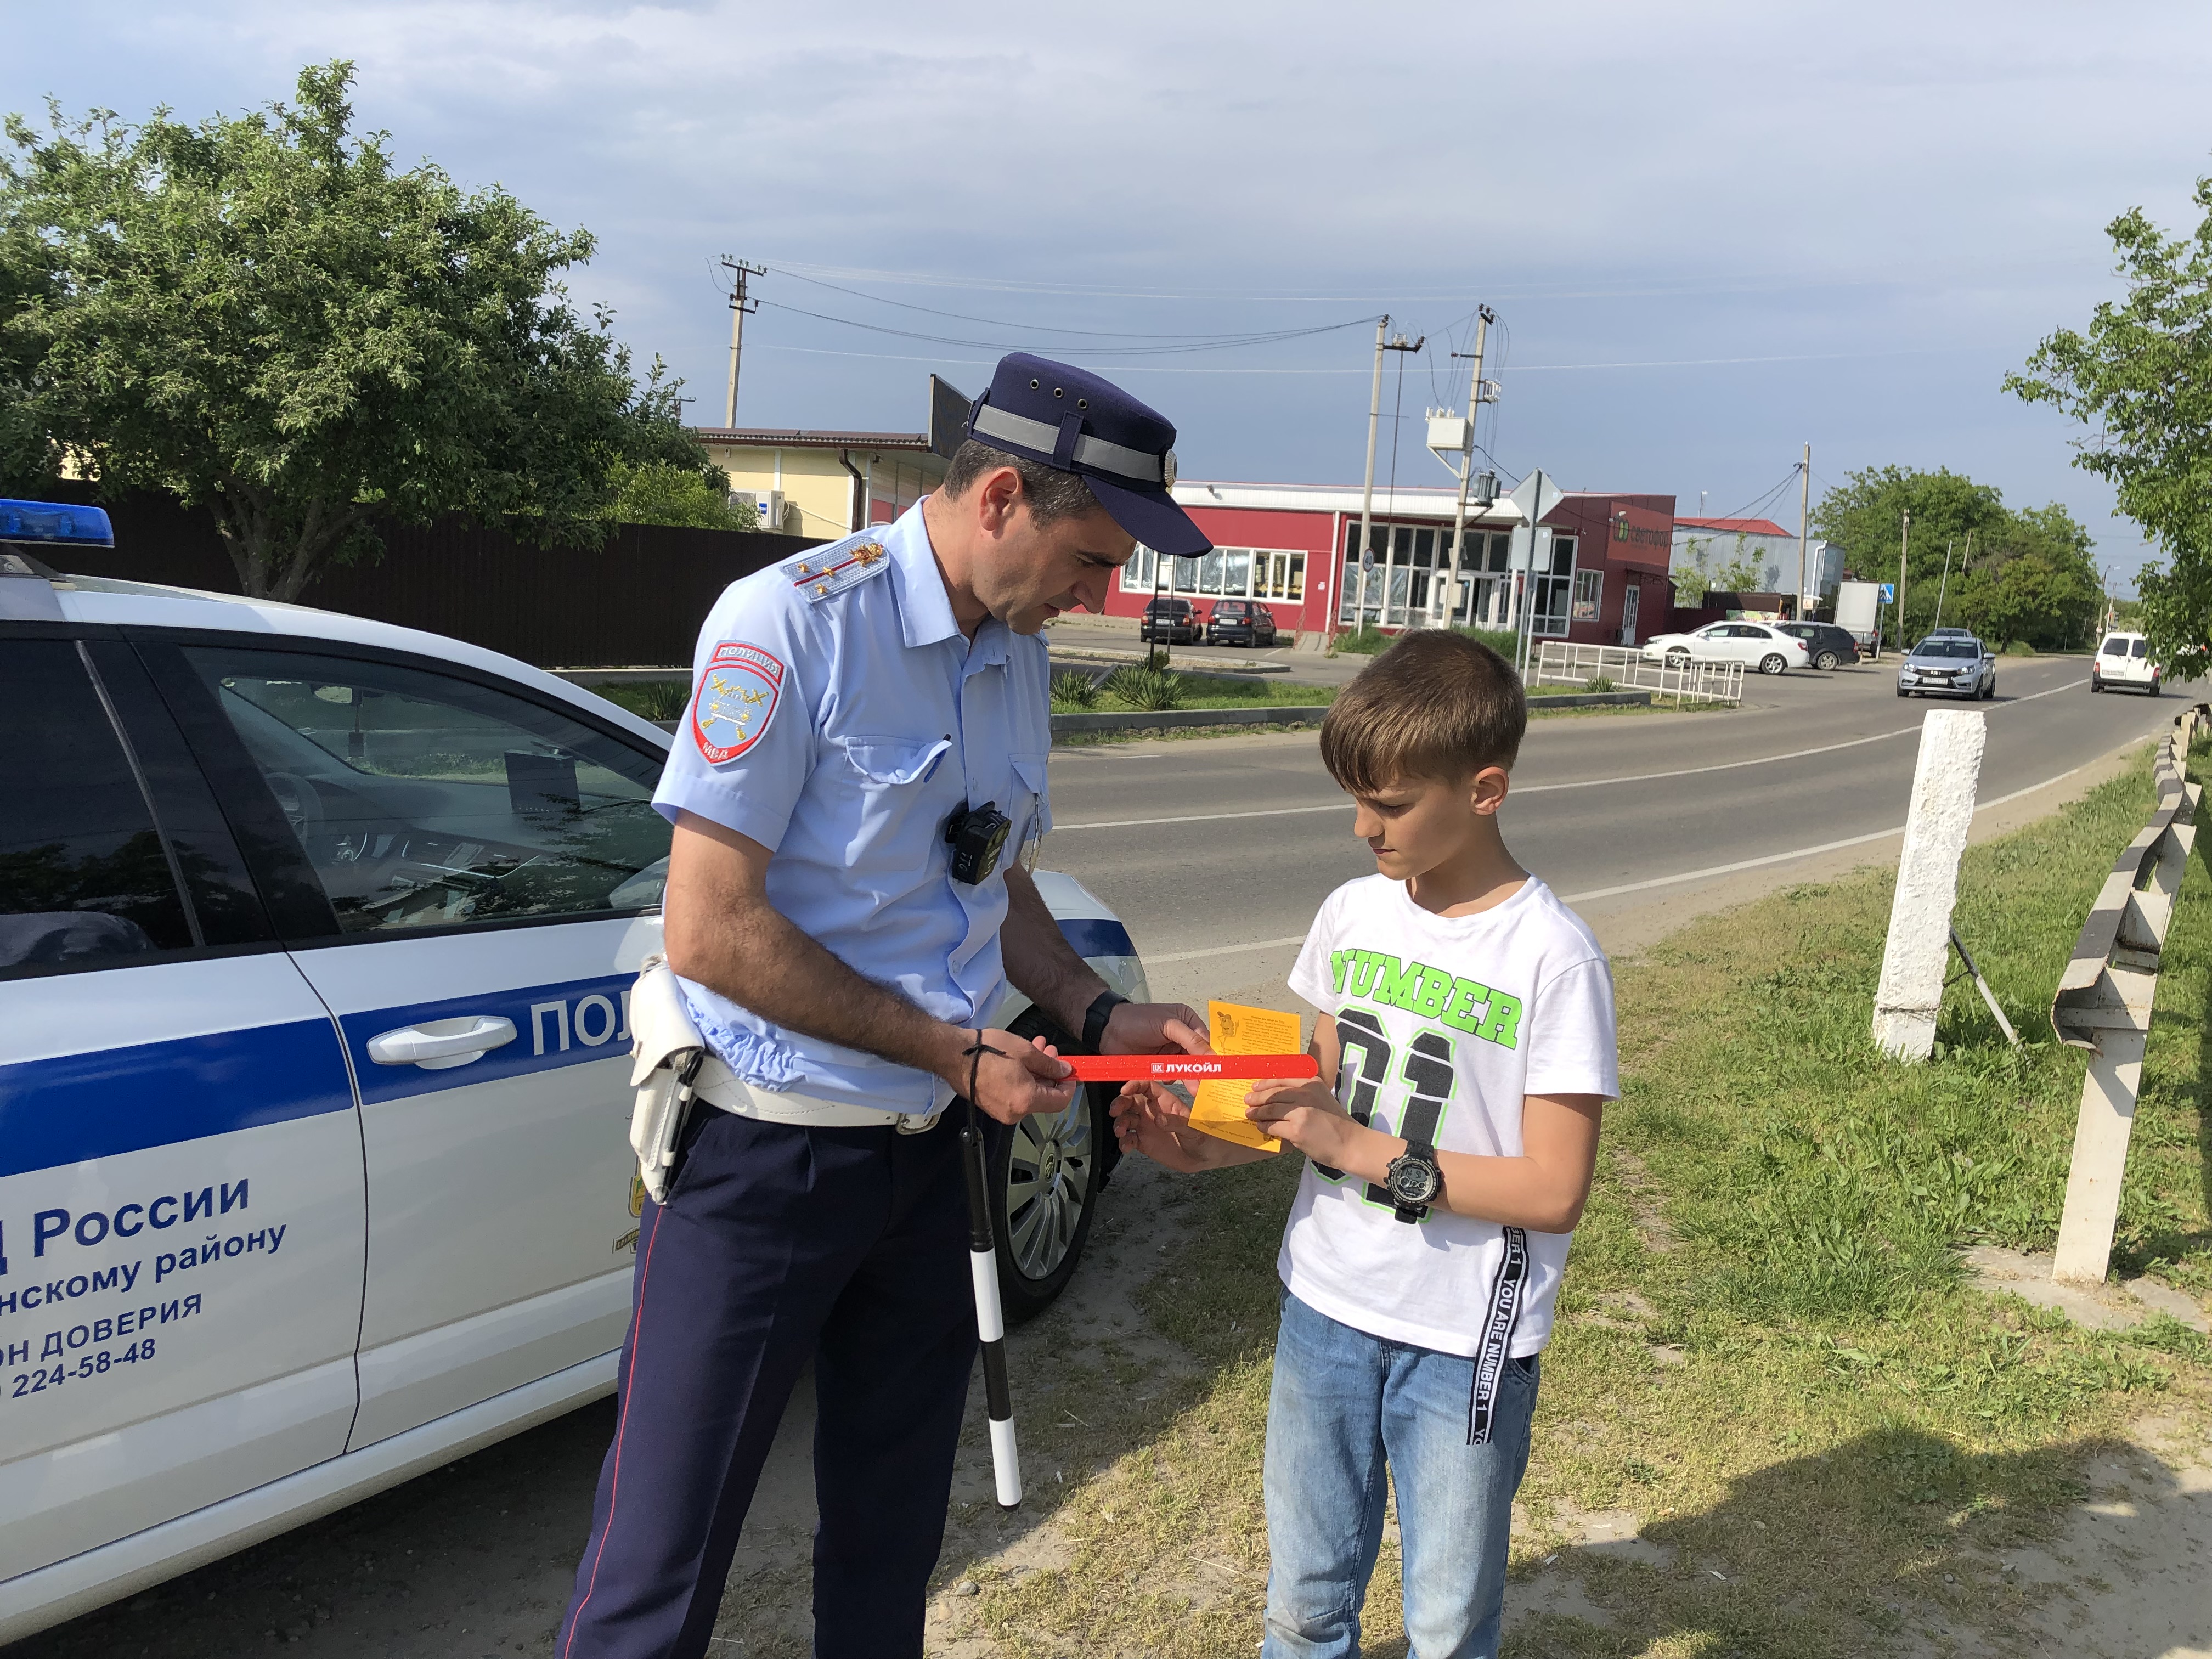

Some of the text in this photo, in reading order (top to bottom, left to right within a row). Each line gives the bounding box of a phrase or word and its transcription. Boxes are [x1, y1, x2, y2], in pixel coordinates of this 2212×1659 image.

[719, 647, 780, 674] ПОЛИЦИЯ
[702, 741, 729, 760] МВД
[1165, 1062, 1222, 1073] ЛУКОЙЛ
[155, 1224, 287, 1283] району
[1499, 1279, 1516, 1309] YOU
[40, 1293, 202, 1362] ДОВЕРИЯ
[1490, 1311, 1509, 1340] ARE
[12, 1338, 156, 1399] 224-58-48
[1477, 1342, 1501, 1400] NUMBER
